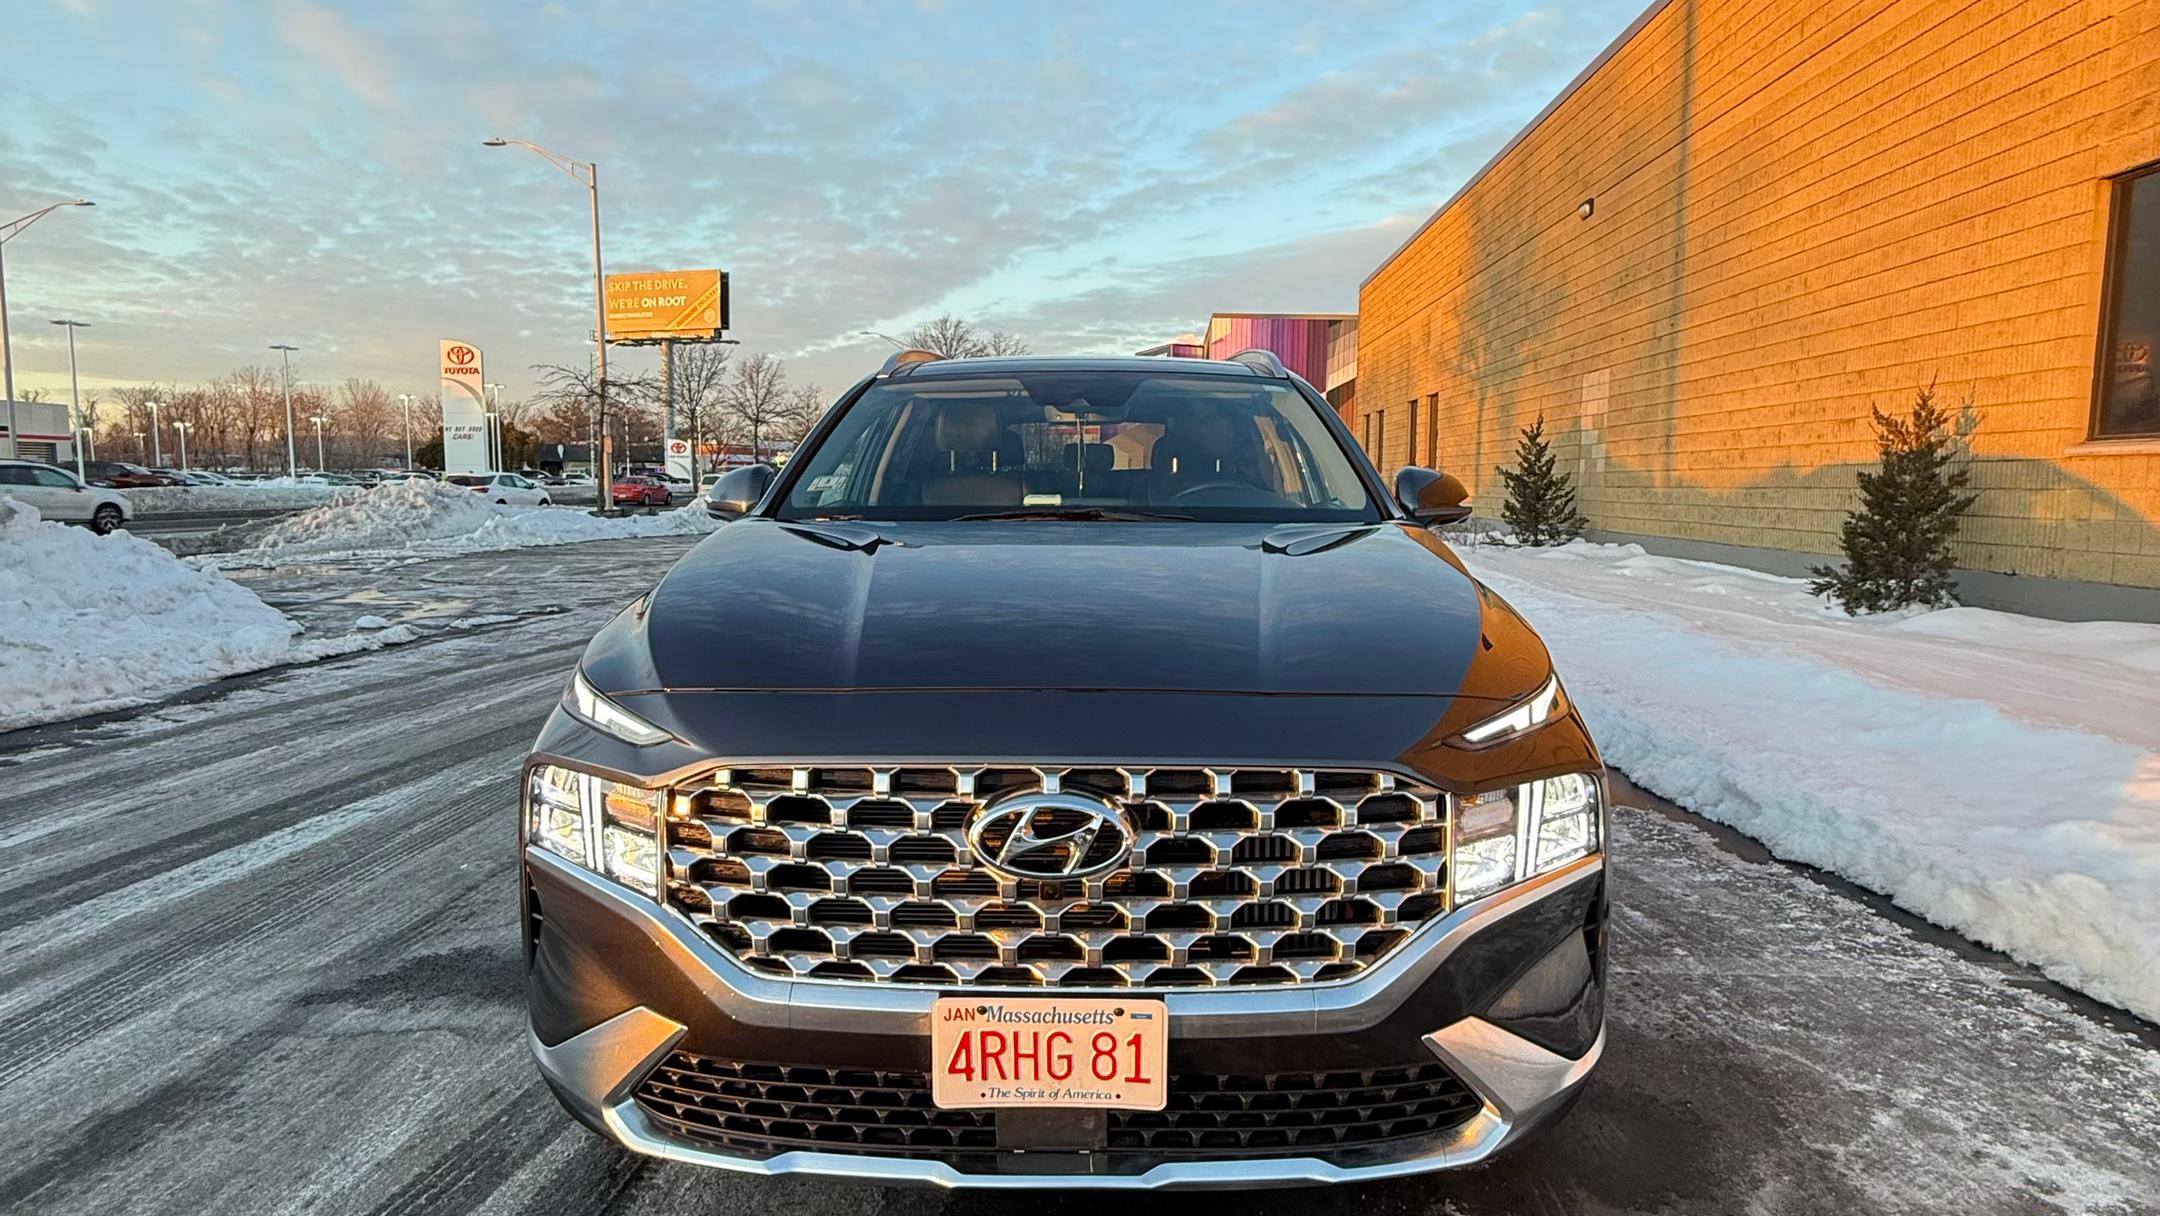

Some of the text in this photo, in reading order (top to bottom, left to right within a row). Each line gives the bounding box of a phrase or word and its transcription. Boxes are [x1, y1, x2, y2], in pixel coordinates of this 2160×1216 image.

[609, 278, 688, 292] SKIP THE DRIVE.
[641, 297, 657, 308] ON
[658, 295, 687, 307] ROOT
[444, 367, 480, 375] TOYOTA
[943, 1005, 1114, 1025] JAN Massachusetts
[947, 1030, 1152, 1084] 4RHG 81
[988, 1086, 1112, 1100] The Spirit of America
